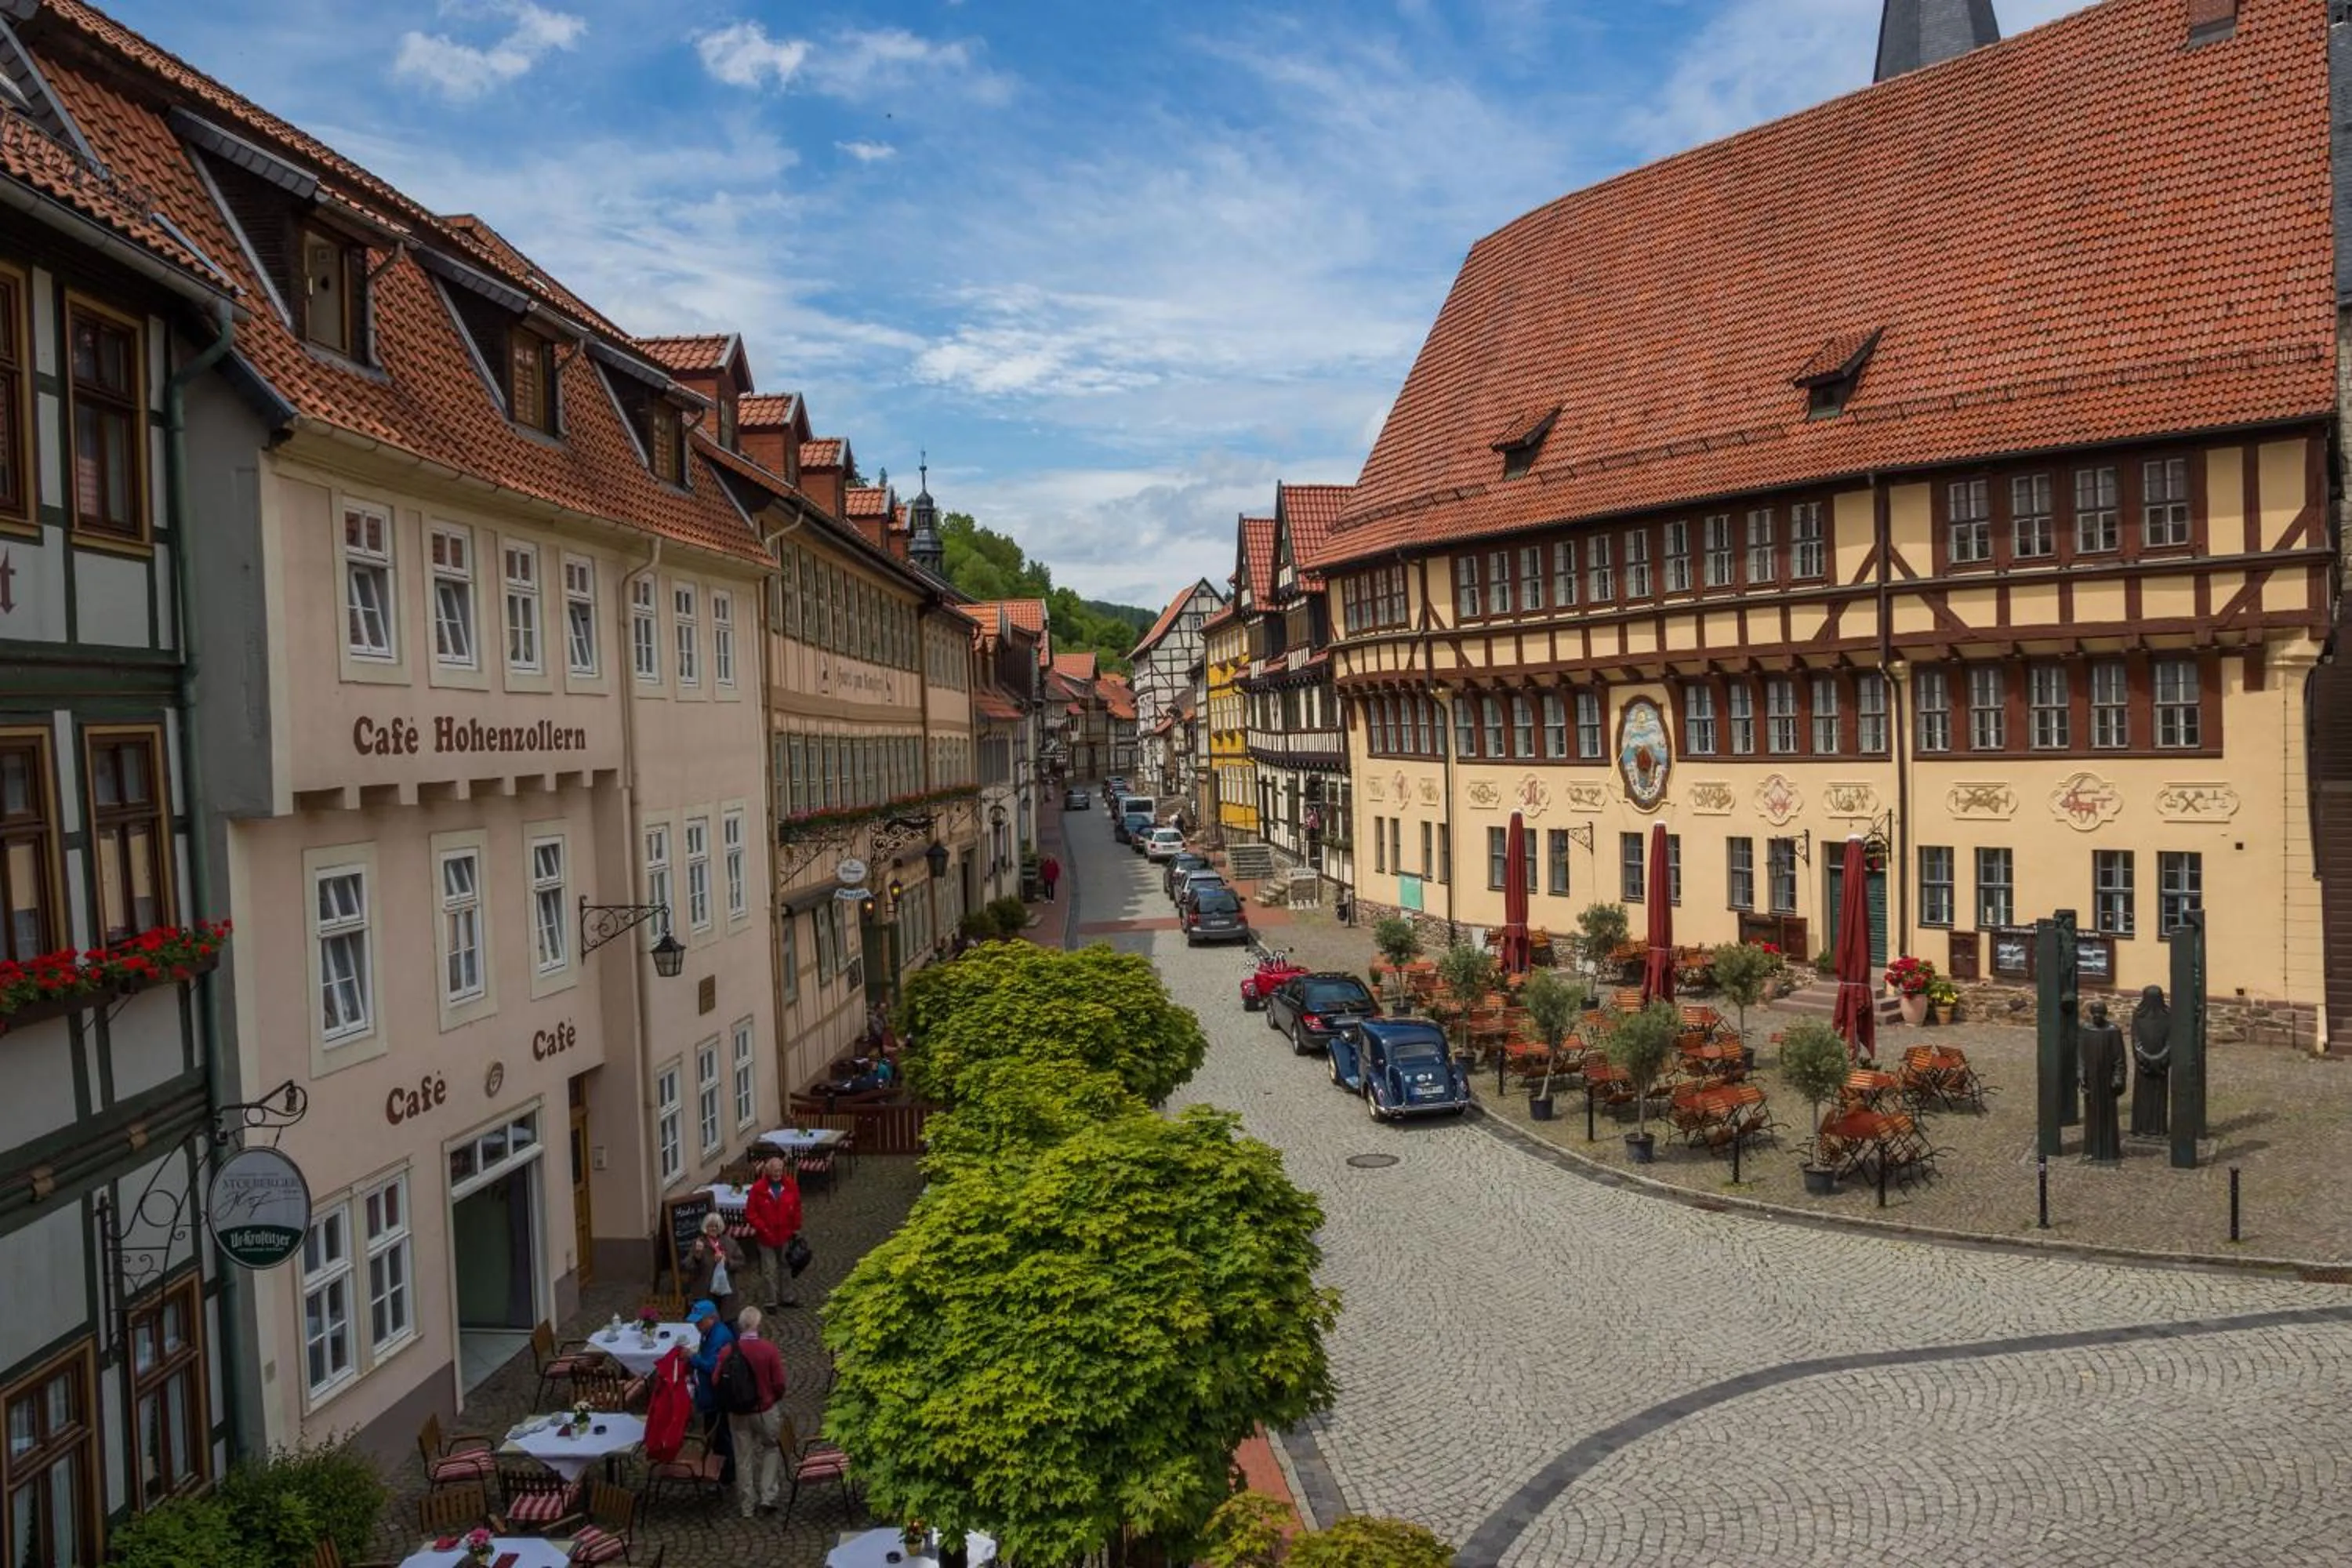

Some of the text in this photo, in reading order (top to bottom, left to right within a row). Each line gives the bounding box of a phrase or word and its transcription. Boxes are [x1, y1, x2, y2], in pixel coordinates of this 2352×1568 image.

[354, 716, 586, 755] Café Hohenzollern
[532, 1018, 576, 1062] Café
[386, 1070, 446, 1126] Café
